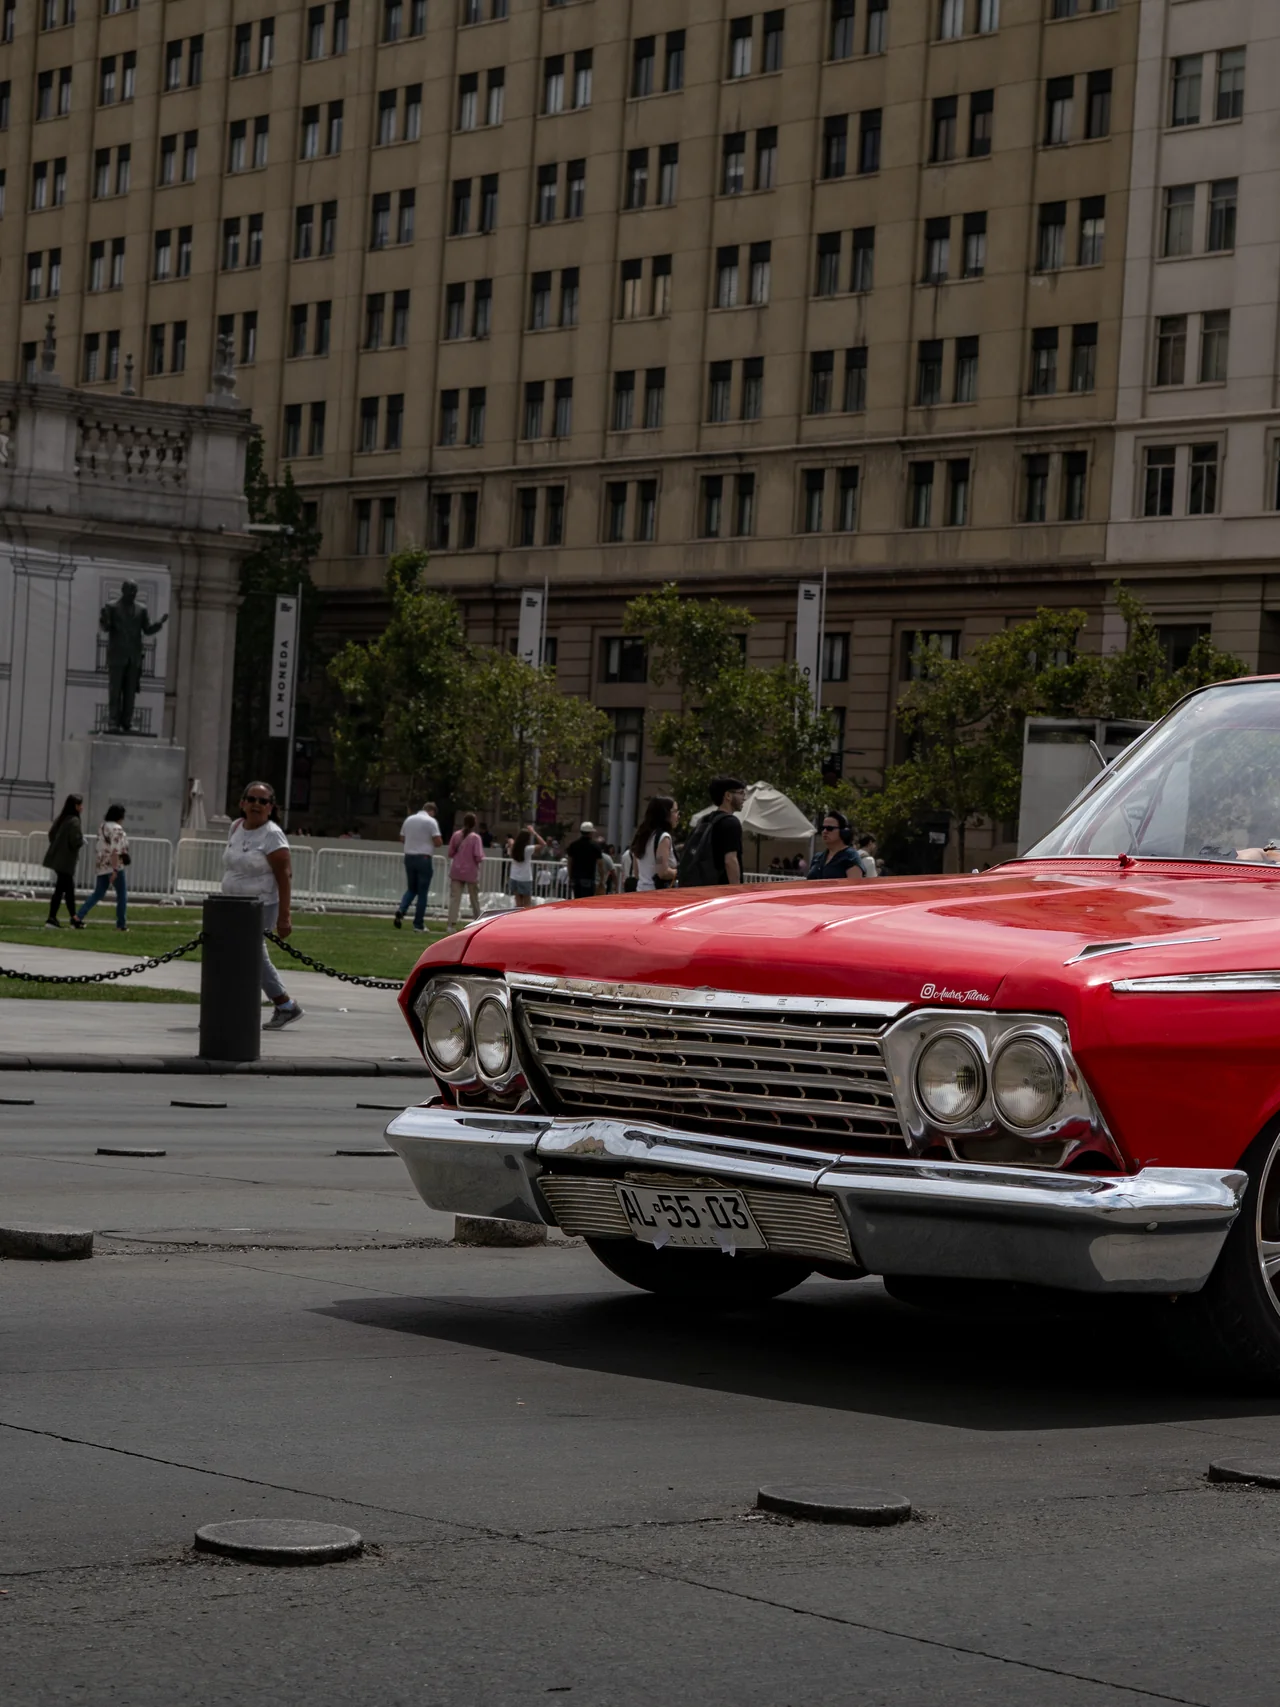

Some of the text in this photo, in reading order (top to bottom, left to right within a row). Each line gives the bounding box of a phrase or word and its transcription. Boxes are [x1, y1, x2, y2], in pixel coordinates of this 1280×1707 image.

[276, 640, 289, 728] LA MONEDA
[669, 1235, 718, 1245] CHILE
